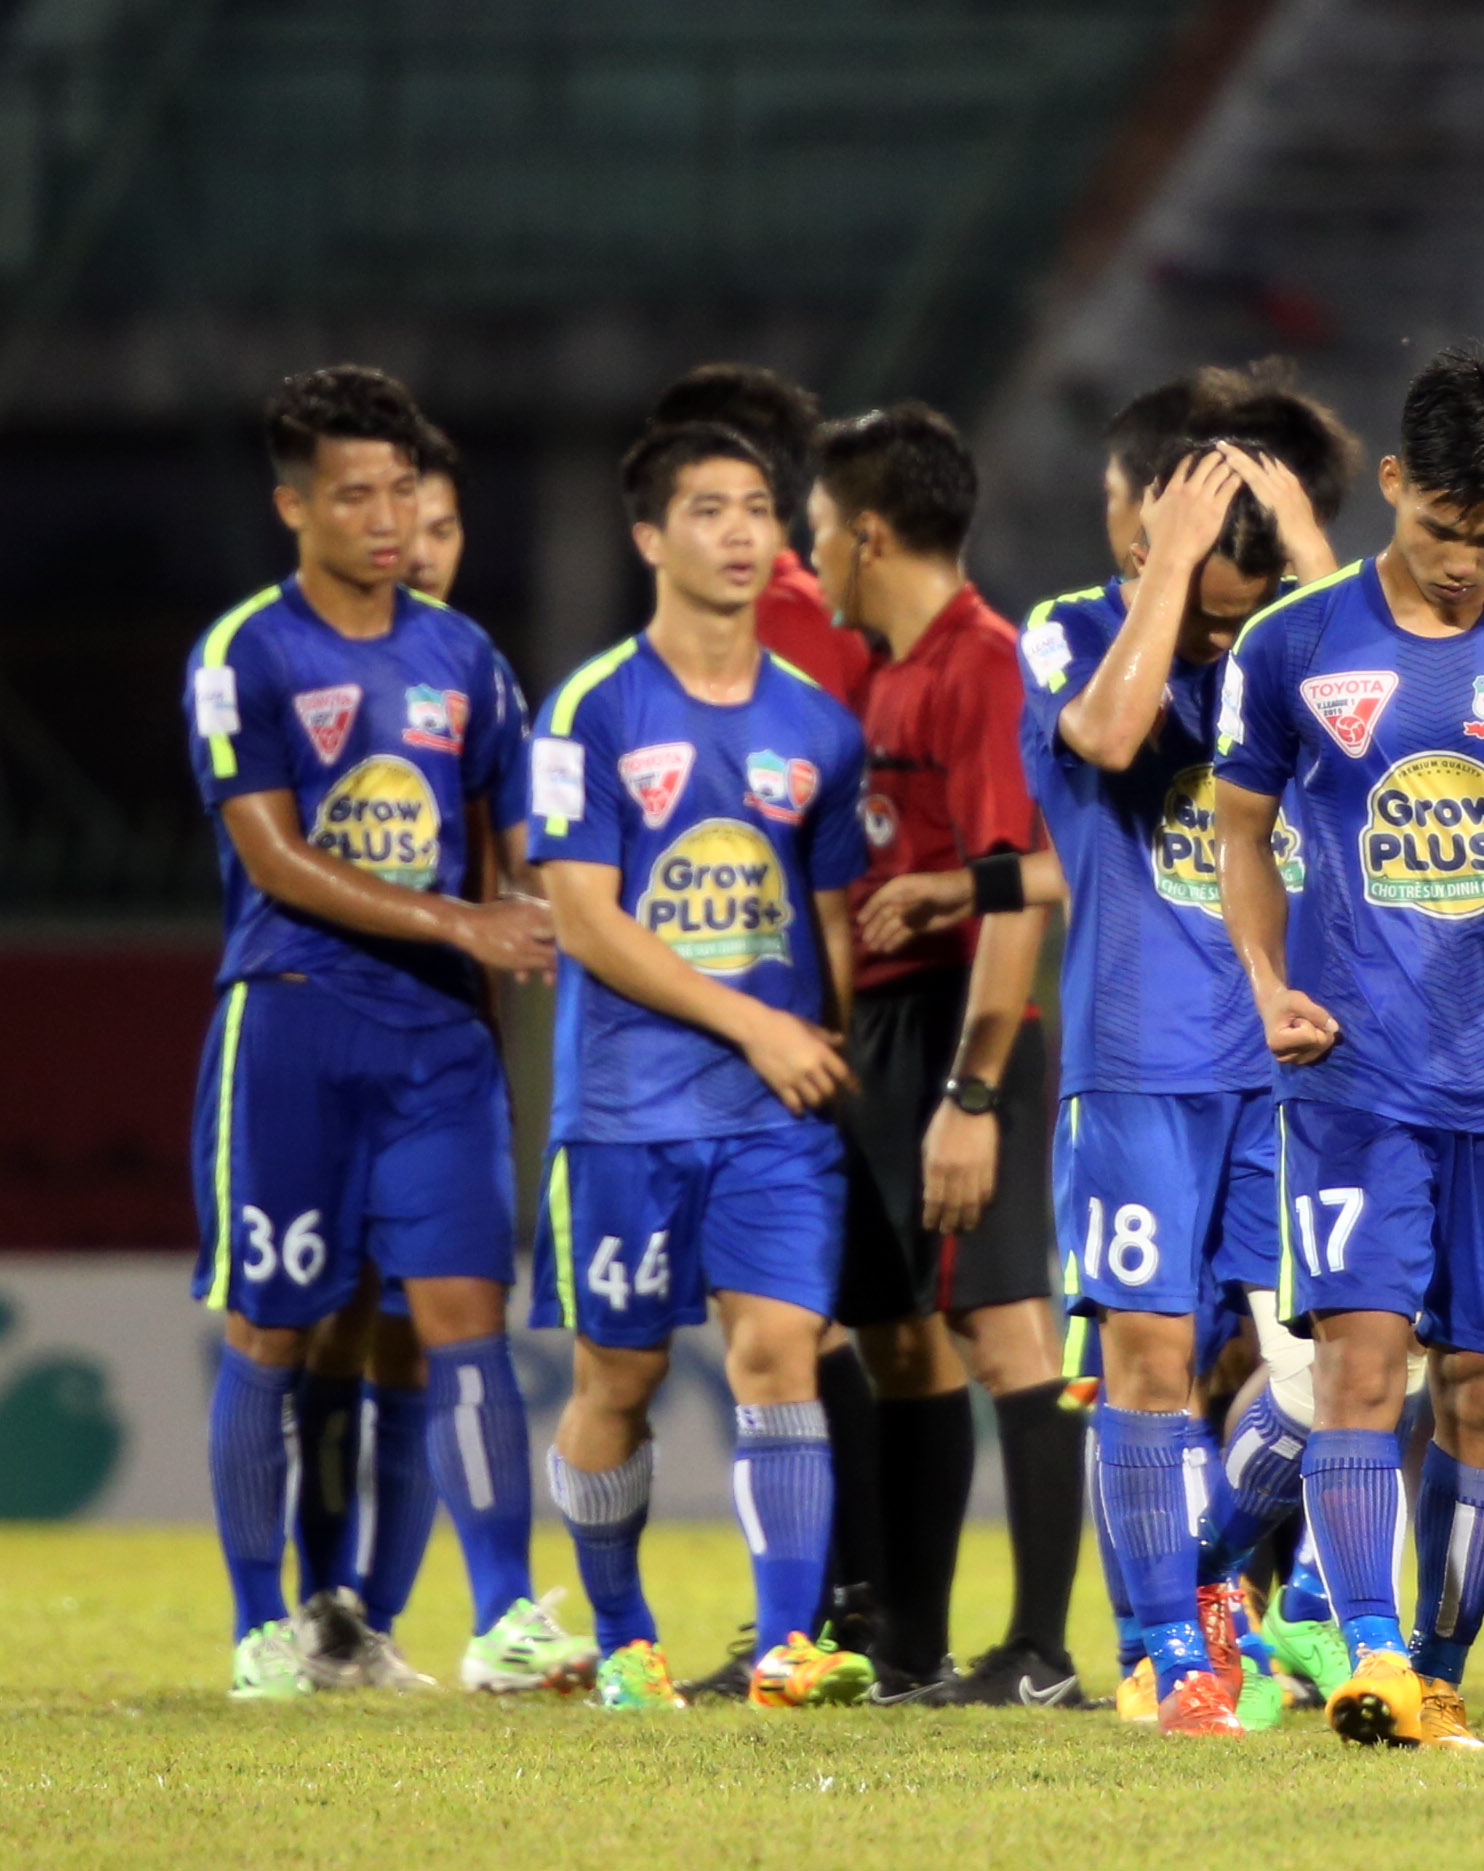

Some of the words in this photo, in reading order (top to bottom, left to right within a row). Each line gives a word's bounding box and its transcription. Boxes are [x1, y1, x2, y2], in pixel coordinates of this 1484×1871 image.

[1310, 680, 1384, 699] TOYOTA
[1442, 761, 1481, 778] QUALITY
[1176, 794, 1215, 832] Gr
[663, 857, 769, 891] Grow
[1370, 883, 1397, 898] CHO
[1448, 881, 1480, 896] DINH
[650, 897, 782, 932] PLUS+
[242, 1204, 327, 1286] 36
[1084, 1196, 1159, 1286] 18
[1295, 1187, 1364, 1277] 17
[587, 1230, 670, 1310] 44
